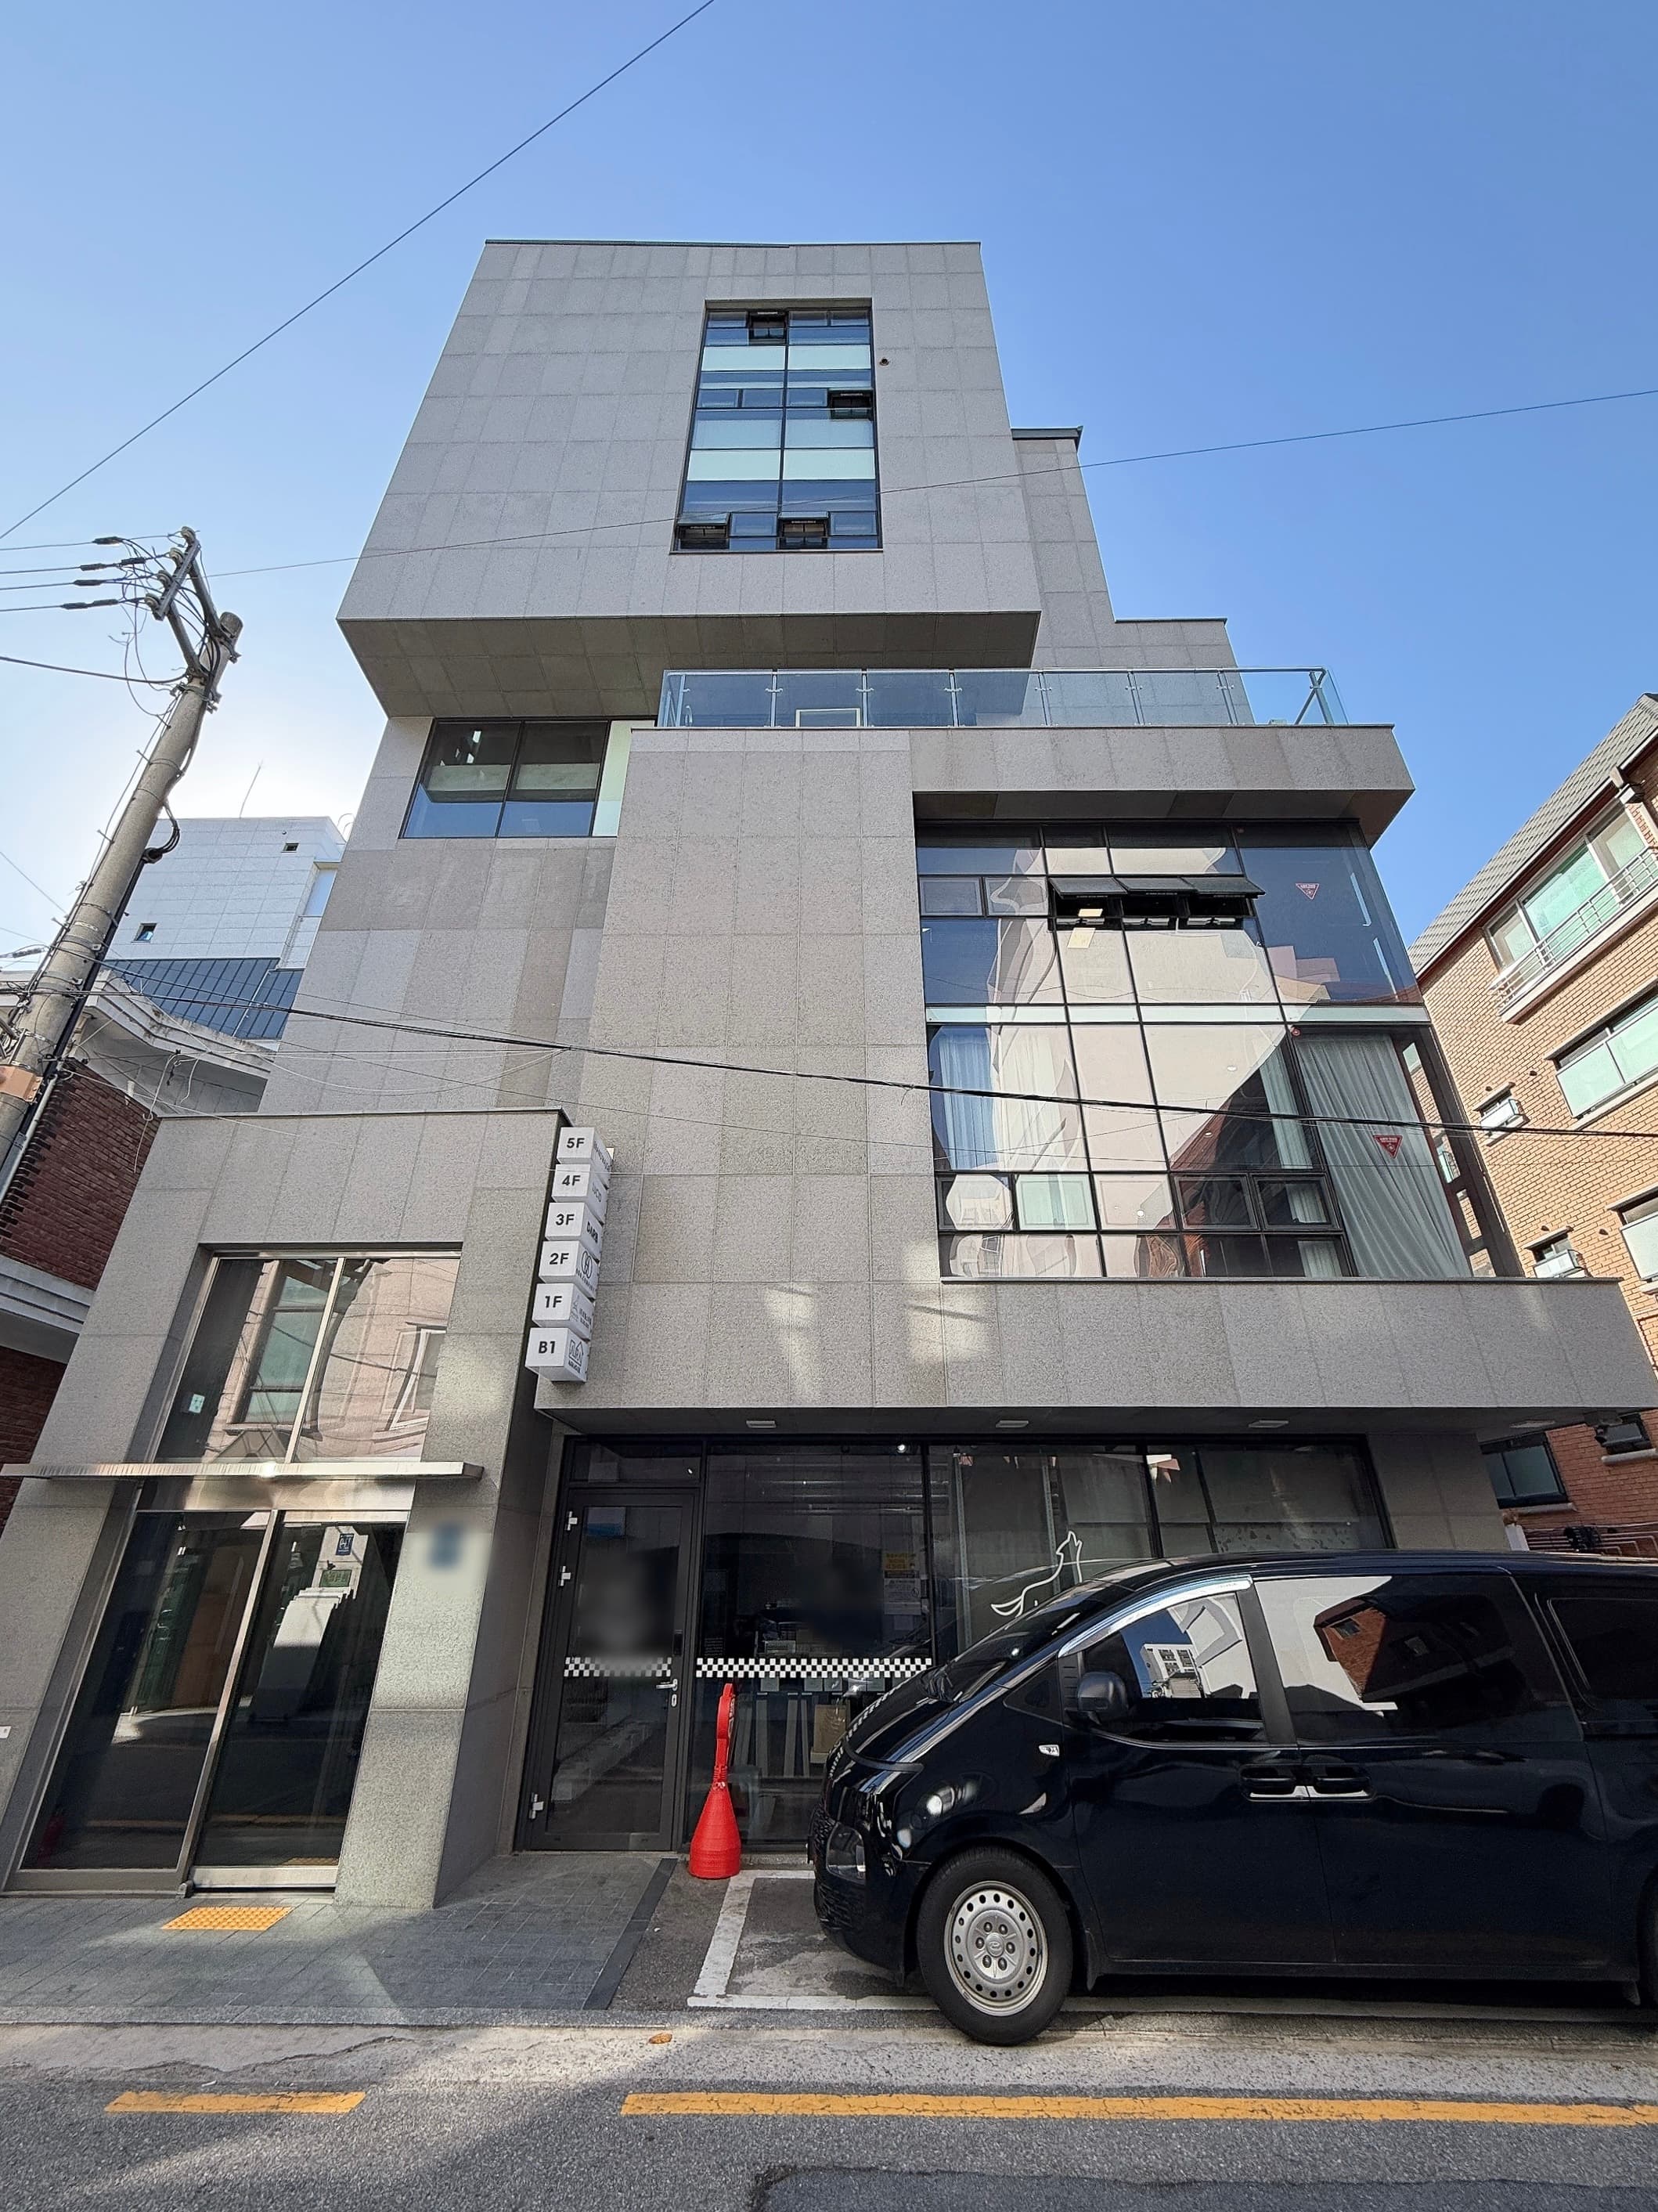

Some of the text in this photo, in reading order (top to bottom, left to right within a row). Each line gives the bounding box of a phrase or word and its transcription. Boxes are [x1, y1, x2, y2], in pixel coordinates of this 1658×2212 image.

[566, 1138, 585, 1149] 5F
[561, 1175, 581, 1186] 4F
[555, 1213, 575, 1225] 3F
[549, 1253, 570, 1265] 2F
[545, 1295, 563, 1308] 1F
[538, 1341, 556, 1354] B1
